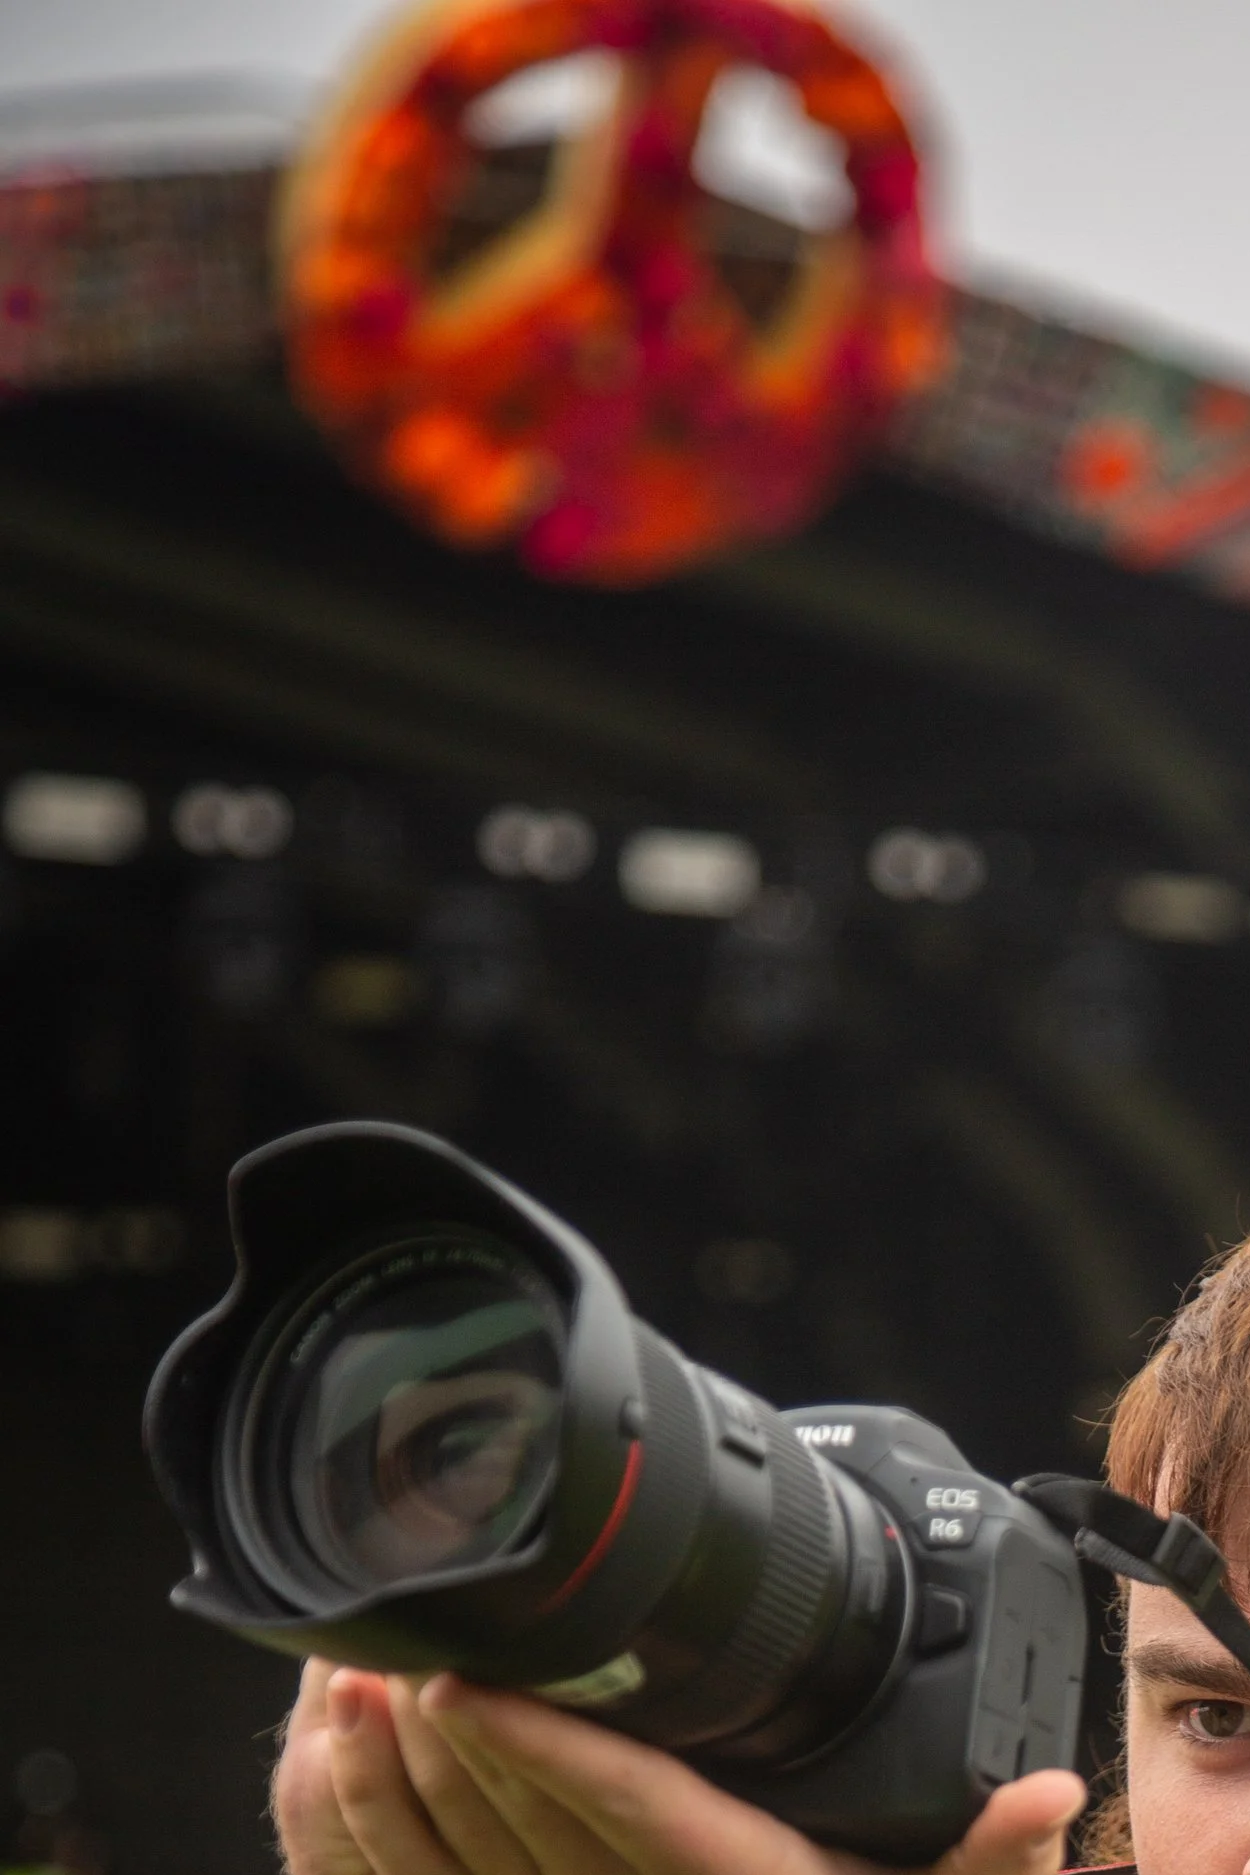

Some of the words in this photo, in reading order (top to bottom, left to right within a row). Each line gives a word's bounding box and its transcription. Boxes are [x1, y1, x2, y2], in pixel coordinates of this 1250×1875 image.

[794, 1424, 855, 1447] non
[925, 1486, 981, 1512] EOS
[928, 1517, 965, 1543] R6
